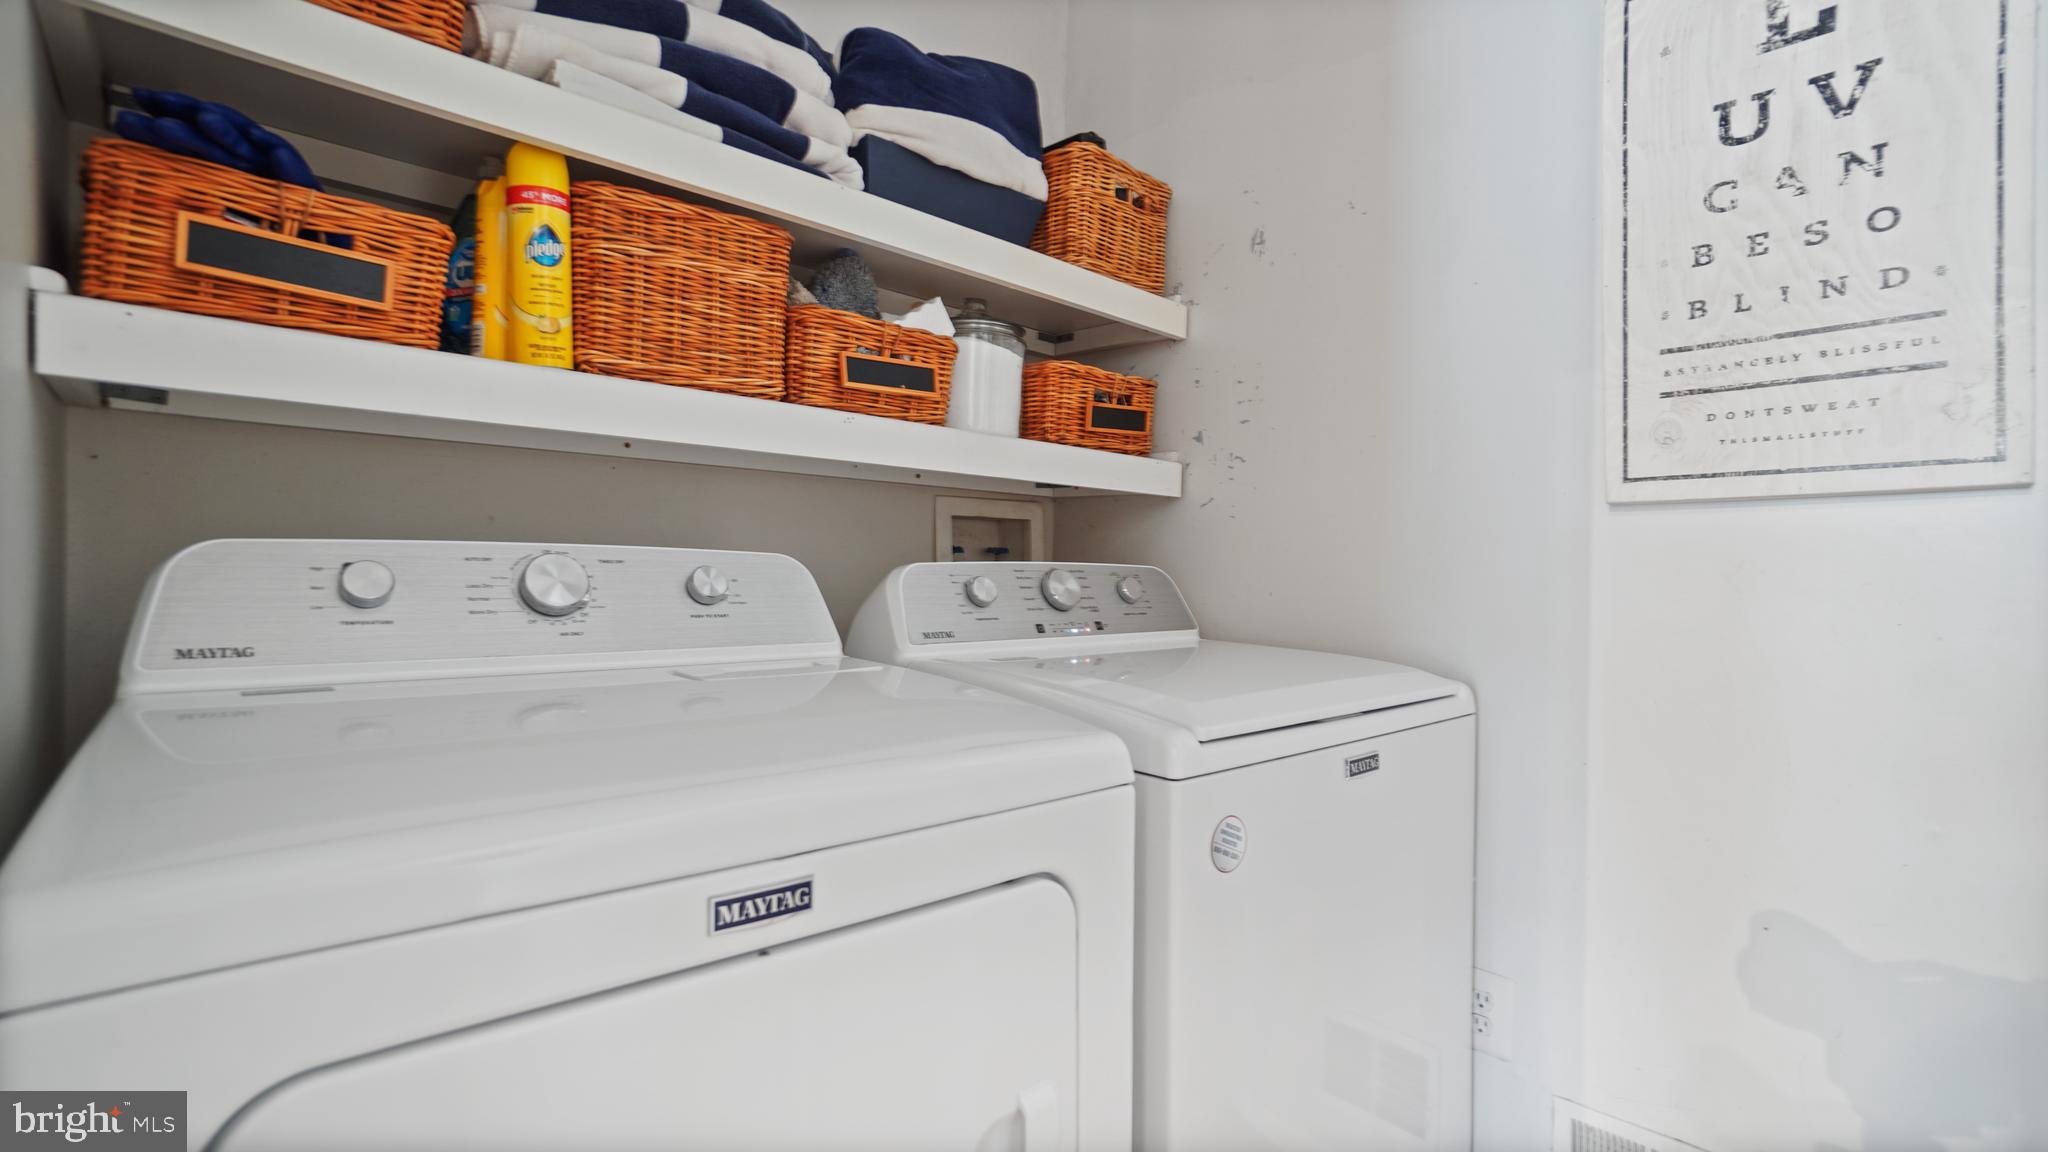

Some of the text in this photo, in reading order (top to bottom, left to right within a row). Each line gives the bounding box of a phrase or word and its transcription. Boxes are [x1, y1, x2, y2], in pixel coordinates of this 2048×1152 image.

[1703, 141, 1890, 214] CAN
[525, 239, 566, 263] pledge
[1687, 266, 1911, 321] BLIND
[1819, 335, 1941, 359] BLISSFUL
[922, 631, 956, 641] MAYTAG
[174, 646, 255, 660] MAYTAG
[717, 887, 810, 926] MAYTAG
